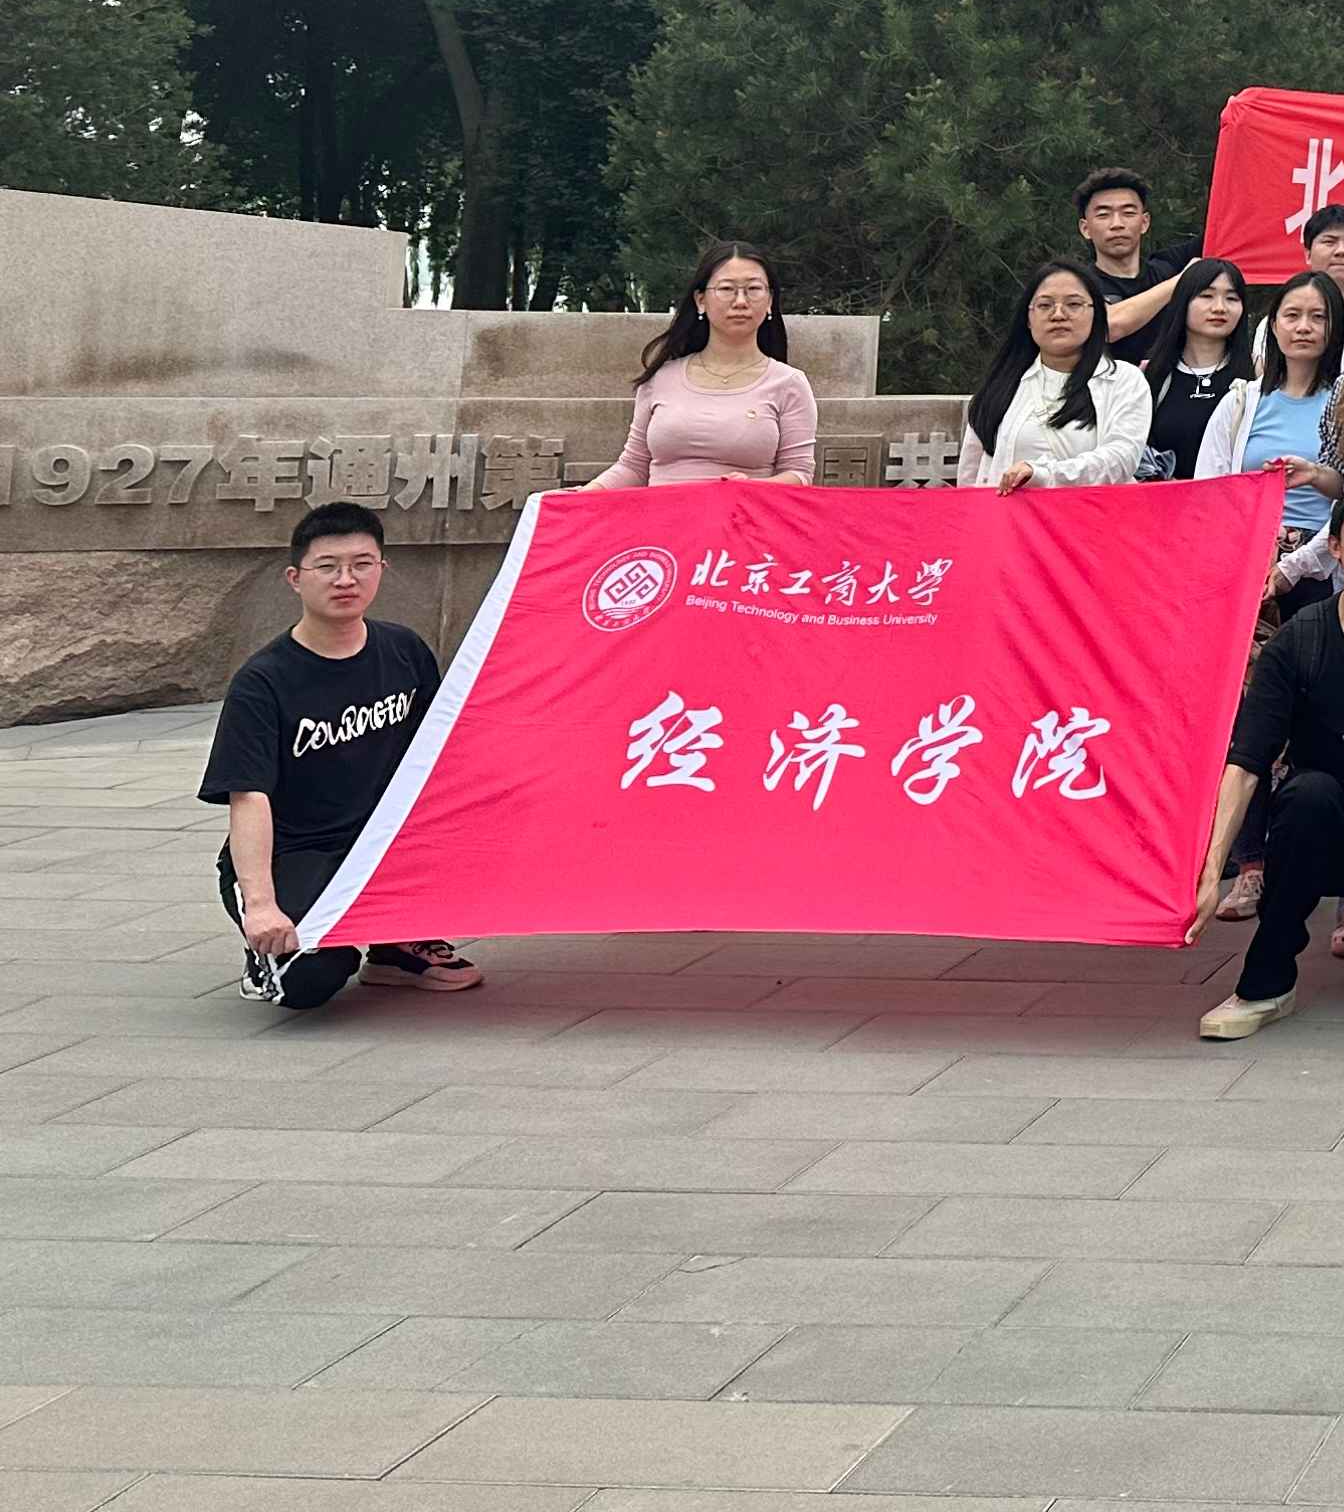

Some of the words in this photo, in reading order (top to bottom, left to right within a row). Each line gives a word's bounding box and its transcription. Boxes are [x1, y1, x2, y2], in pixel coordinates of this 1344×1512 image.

[685, 595, 728, 613] Beijing
[731, 600, 800, 624] Technology
[801, 610, 825, 625] and
[827, 614, 880, 626] Business
[883, 613, 938, 626] University
[620, 691, 1110, 811] 经济学院
